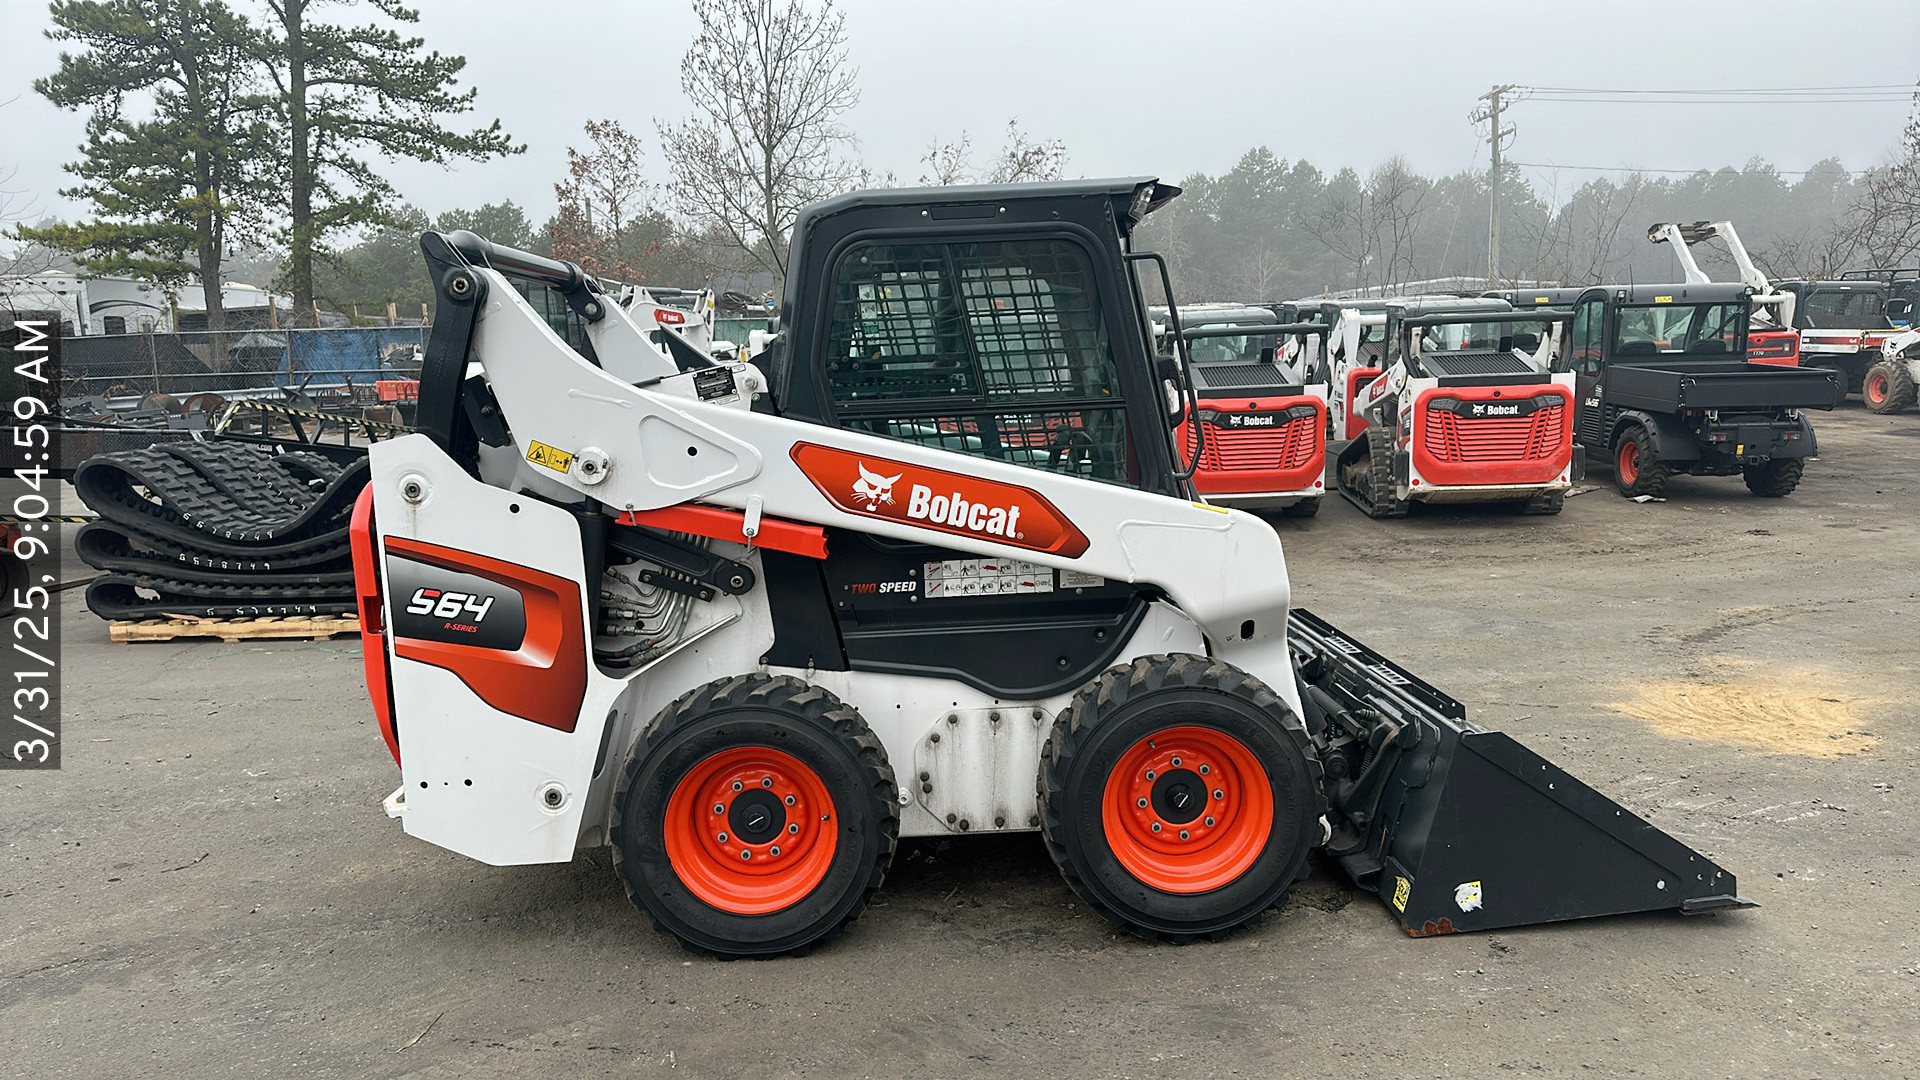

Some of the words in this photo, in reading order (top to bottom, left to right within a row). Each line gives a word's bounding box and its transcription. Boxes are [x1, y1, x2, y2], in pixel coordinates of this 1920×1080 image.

[1486, 404, 1519, 416] Bobcat
[1243, 415, 1274, 426] Bobcat
[907, 483, 1020, 539] Bobcat
[851, 582, 877, 595] TWO
[879, 580, 917, 594] SPEED
[406, 588, 495, 623] S64
[443, 622, 479, 633] R-SERIES
